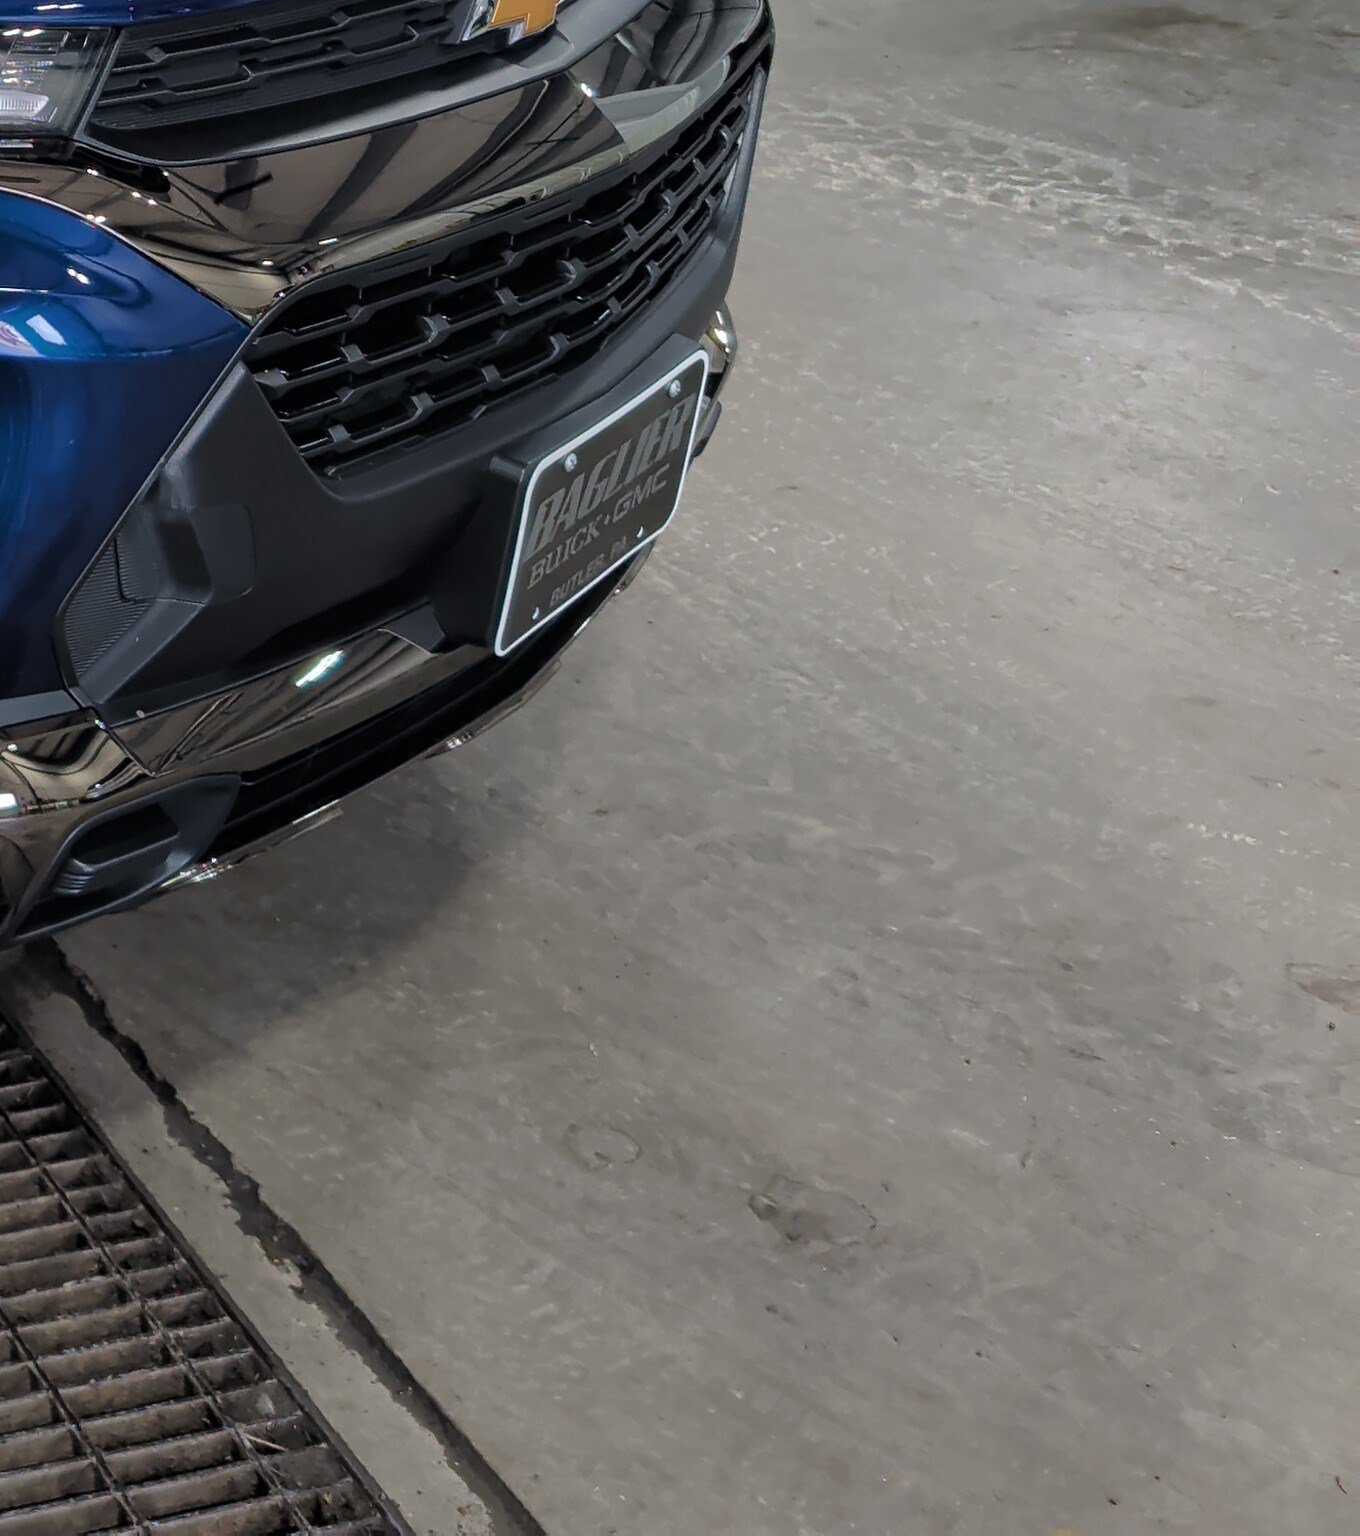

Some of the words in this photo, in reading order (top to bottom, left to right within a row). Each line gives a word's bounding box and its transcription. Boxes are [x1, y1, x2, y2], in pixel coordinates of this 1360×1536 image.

[525, 394, 696, 562] BAGLIER
[527, 515, 602, 590] BUICK
[612, 463, 671, 524] GMC
